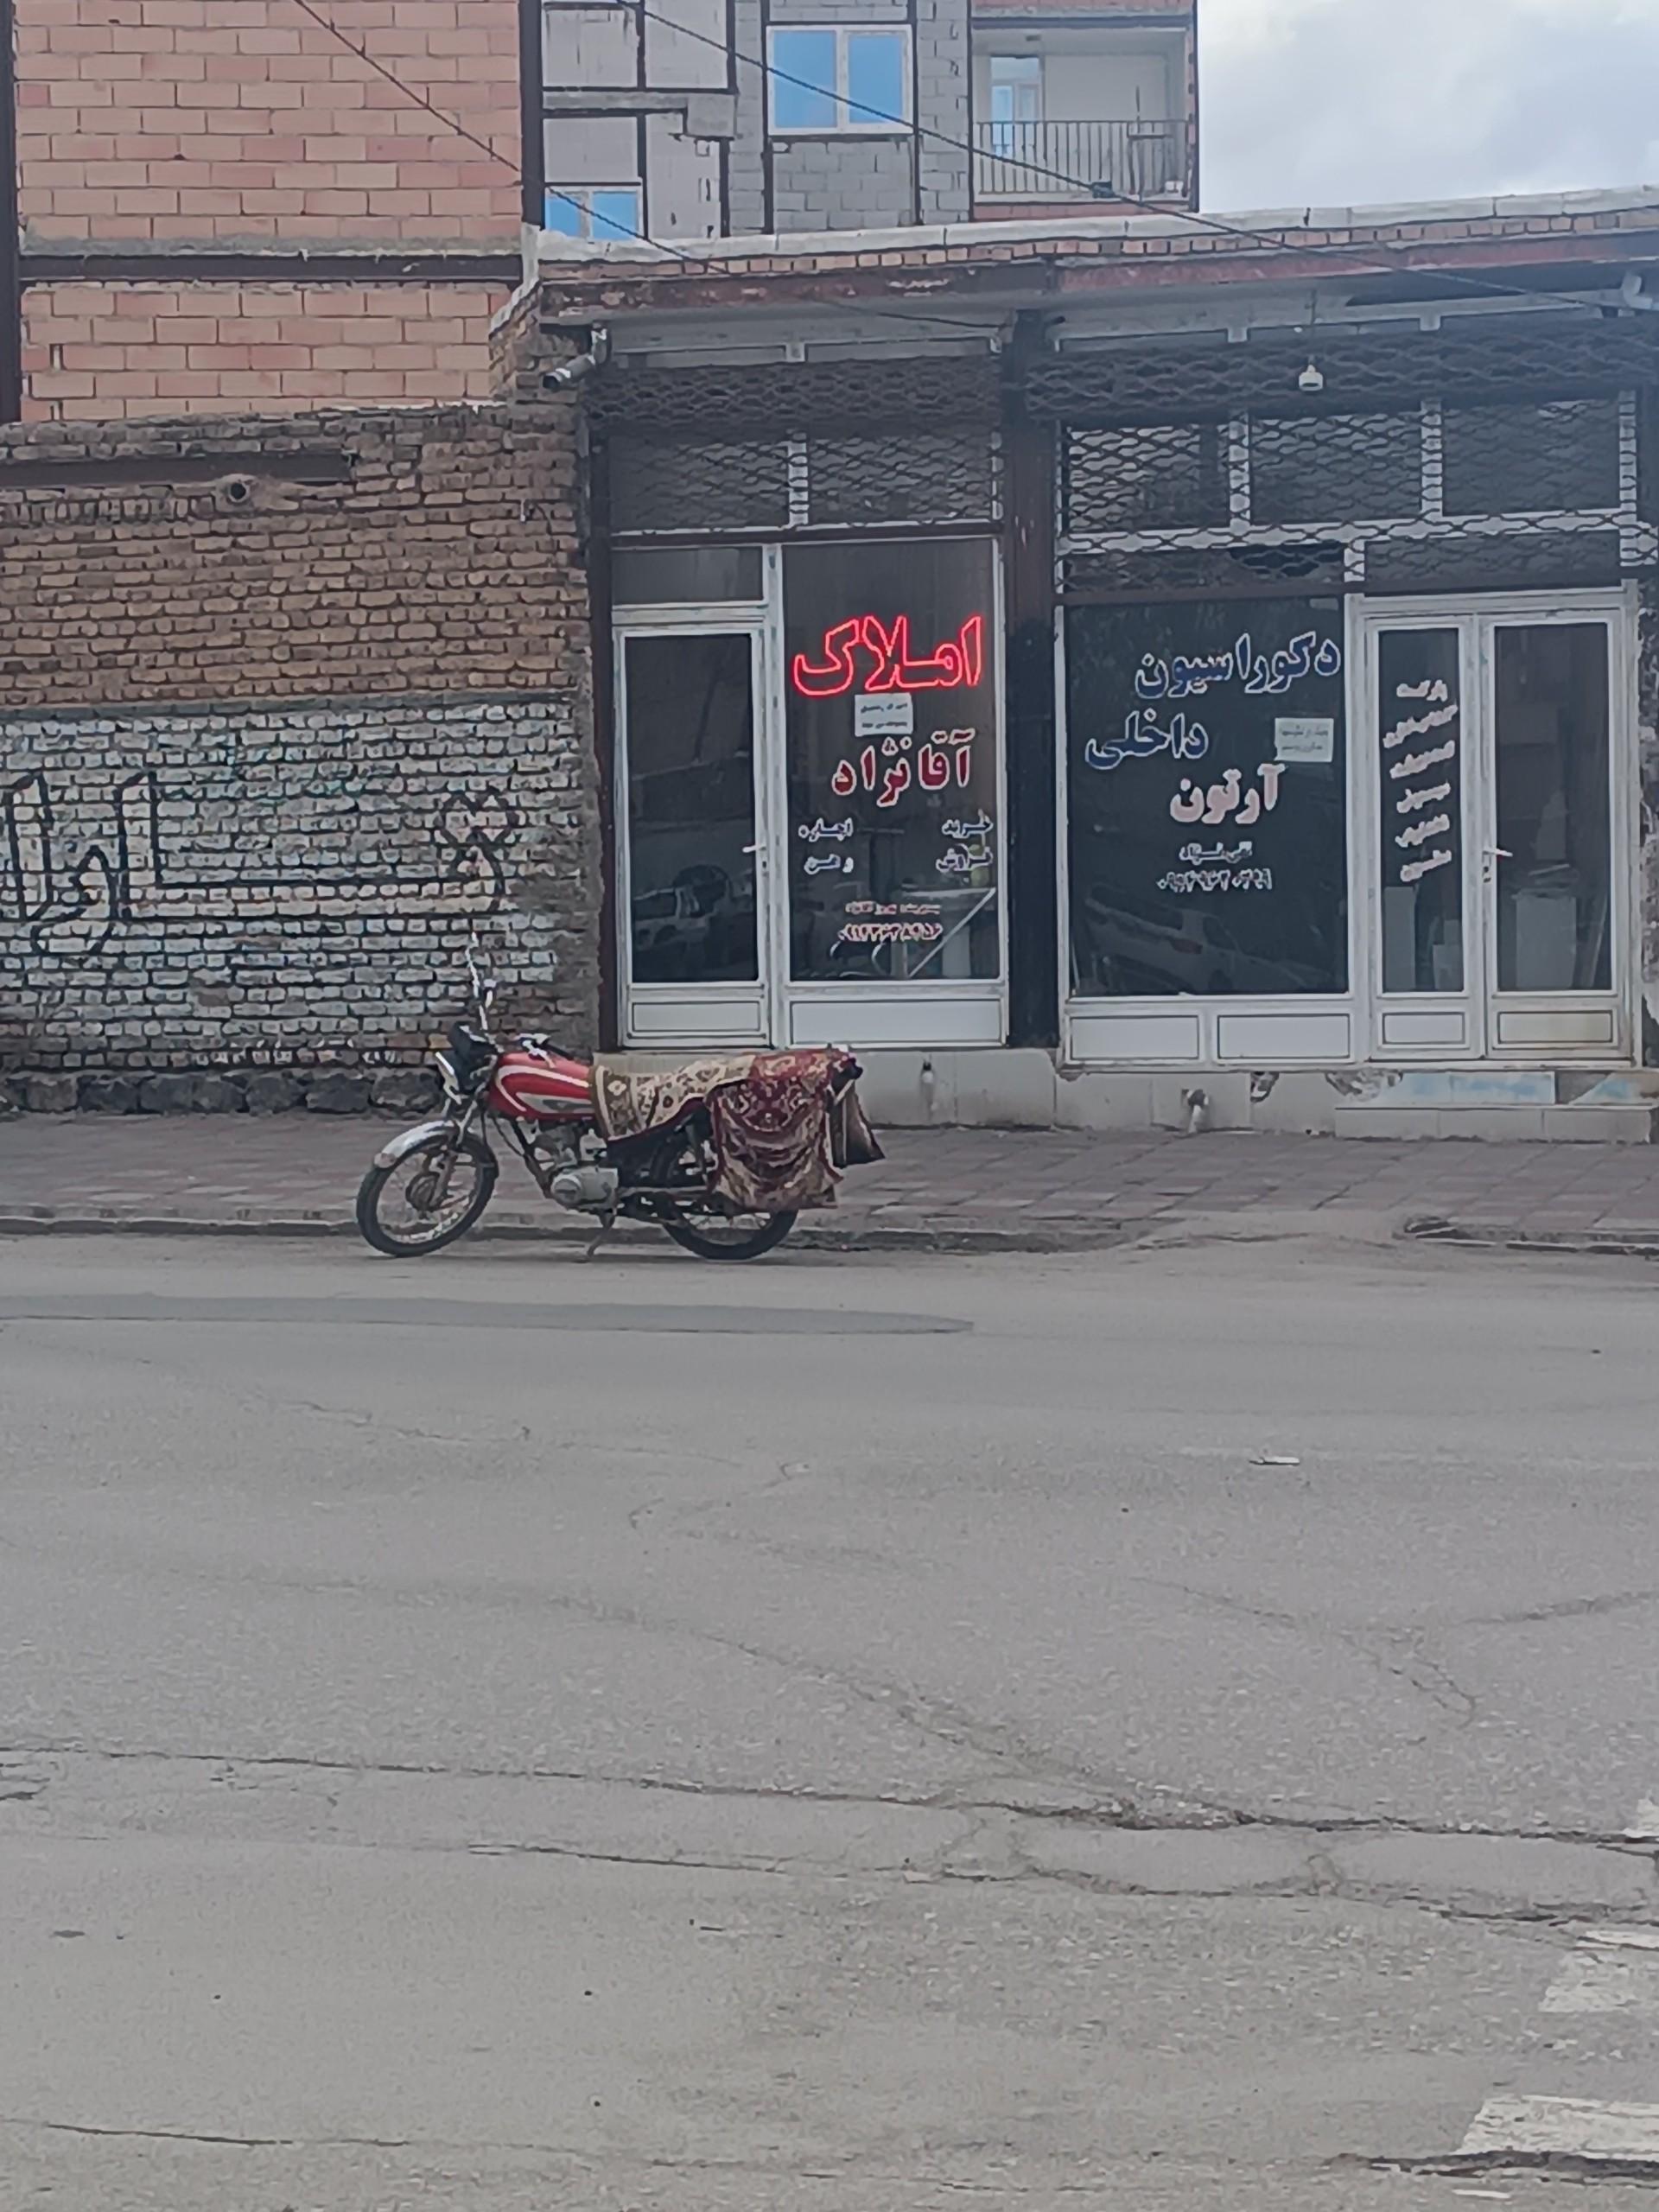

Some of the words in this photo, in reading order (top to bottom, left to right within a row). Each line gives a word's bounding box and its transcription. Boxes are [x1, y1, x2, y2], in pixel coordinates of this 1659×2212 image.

[793, 615, 982, 696] املاک
[1135, 631, 1341, 699] دکوراسیون
[1084, 709, 1209, 770] داخلی
[941, 815, 994, 839] خرید
